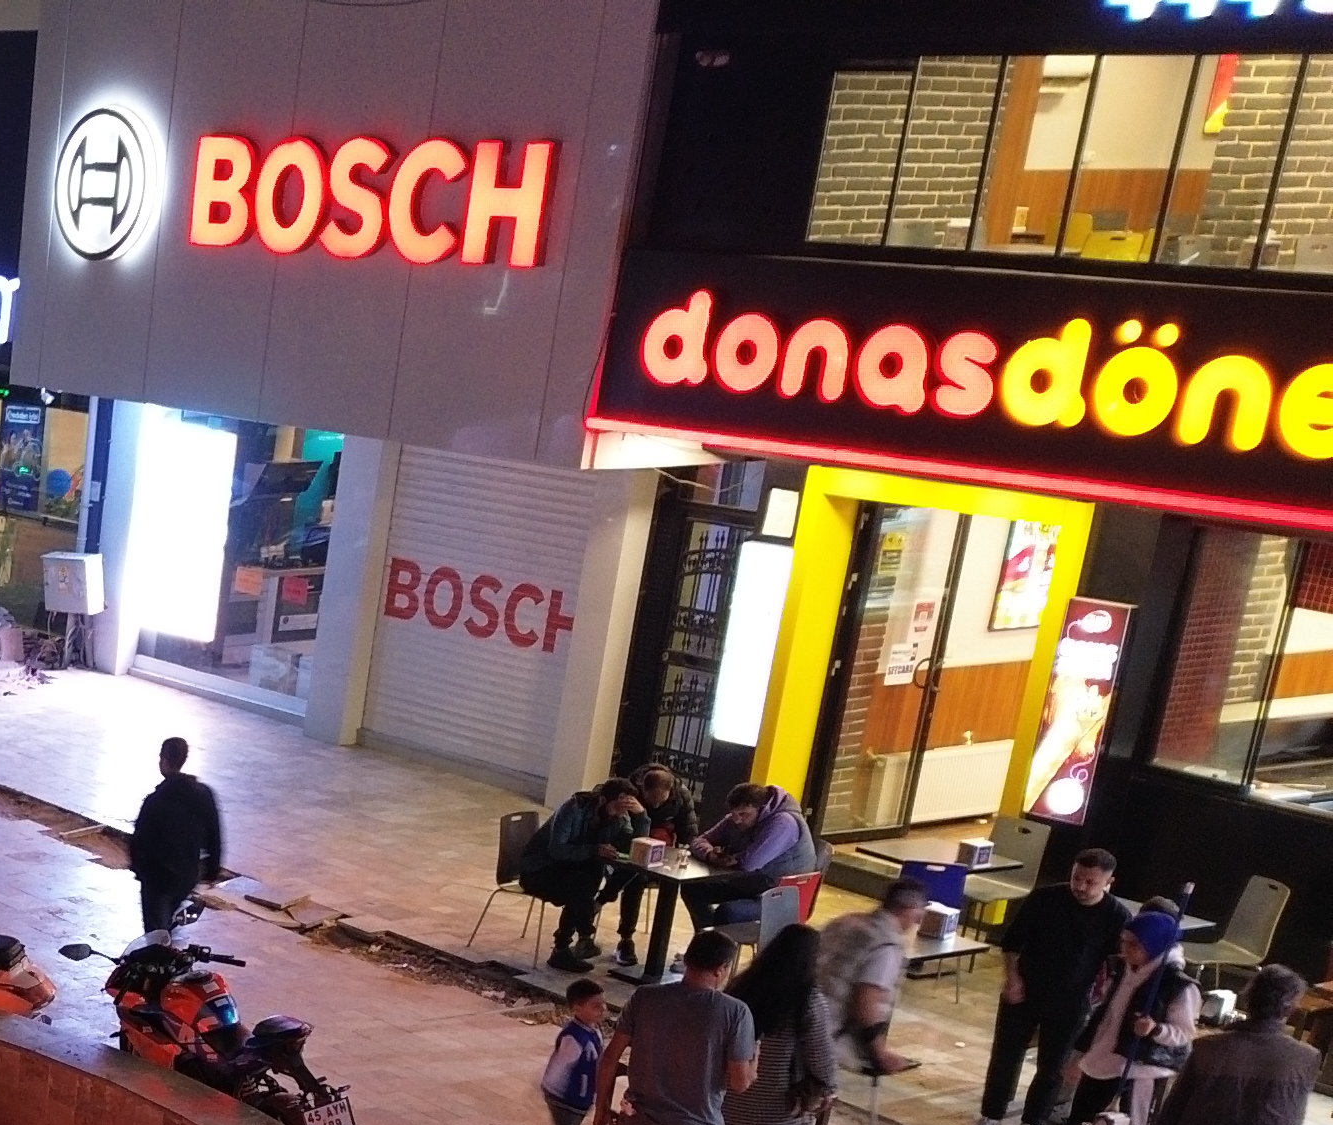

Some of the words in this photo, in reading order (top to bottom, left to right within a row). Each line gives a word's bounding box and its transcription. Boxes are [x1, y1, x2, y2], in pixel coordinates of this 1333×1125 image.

[189, 133, 554, 268] BOSCH
[384, 556, 574, 653] BOSCH
[308, 1110, 321, 1123] 45
